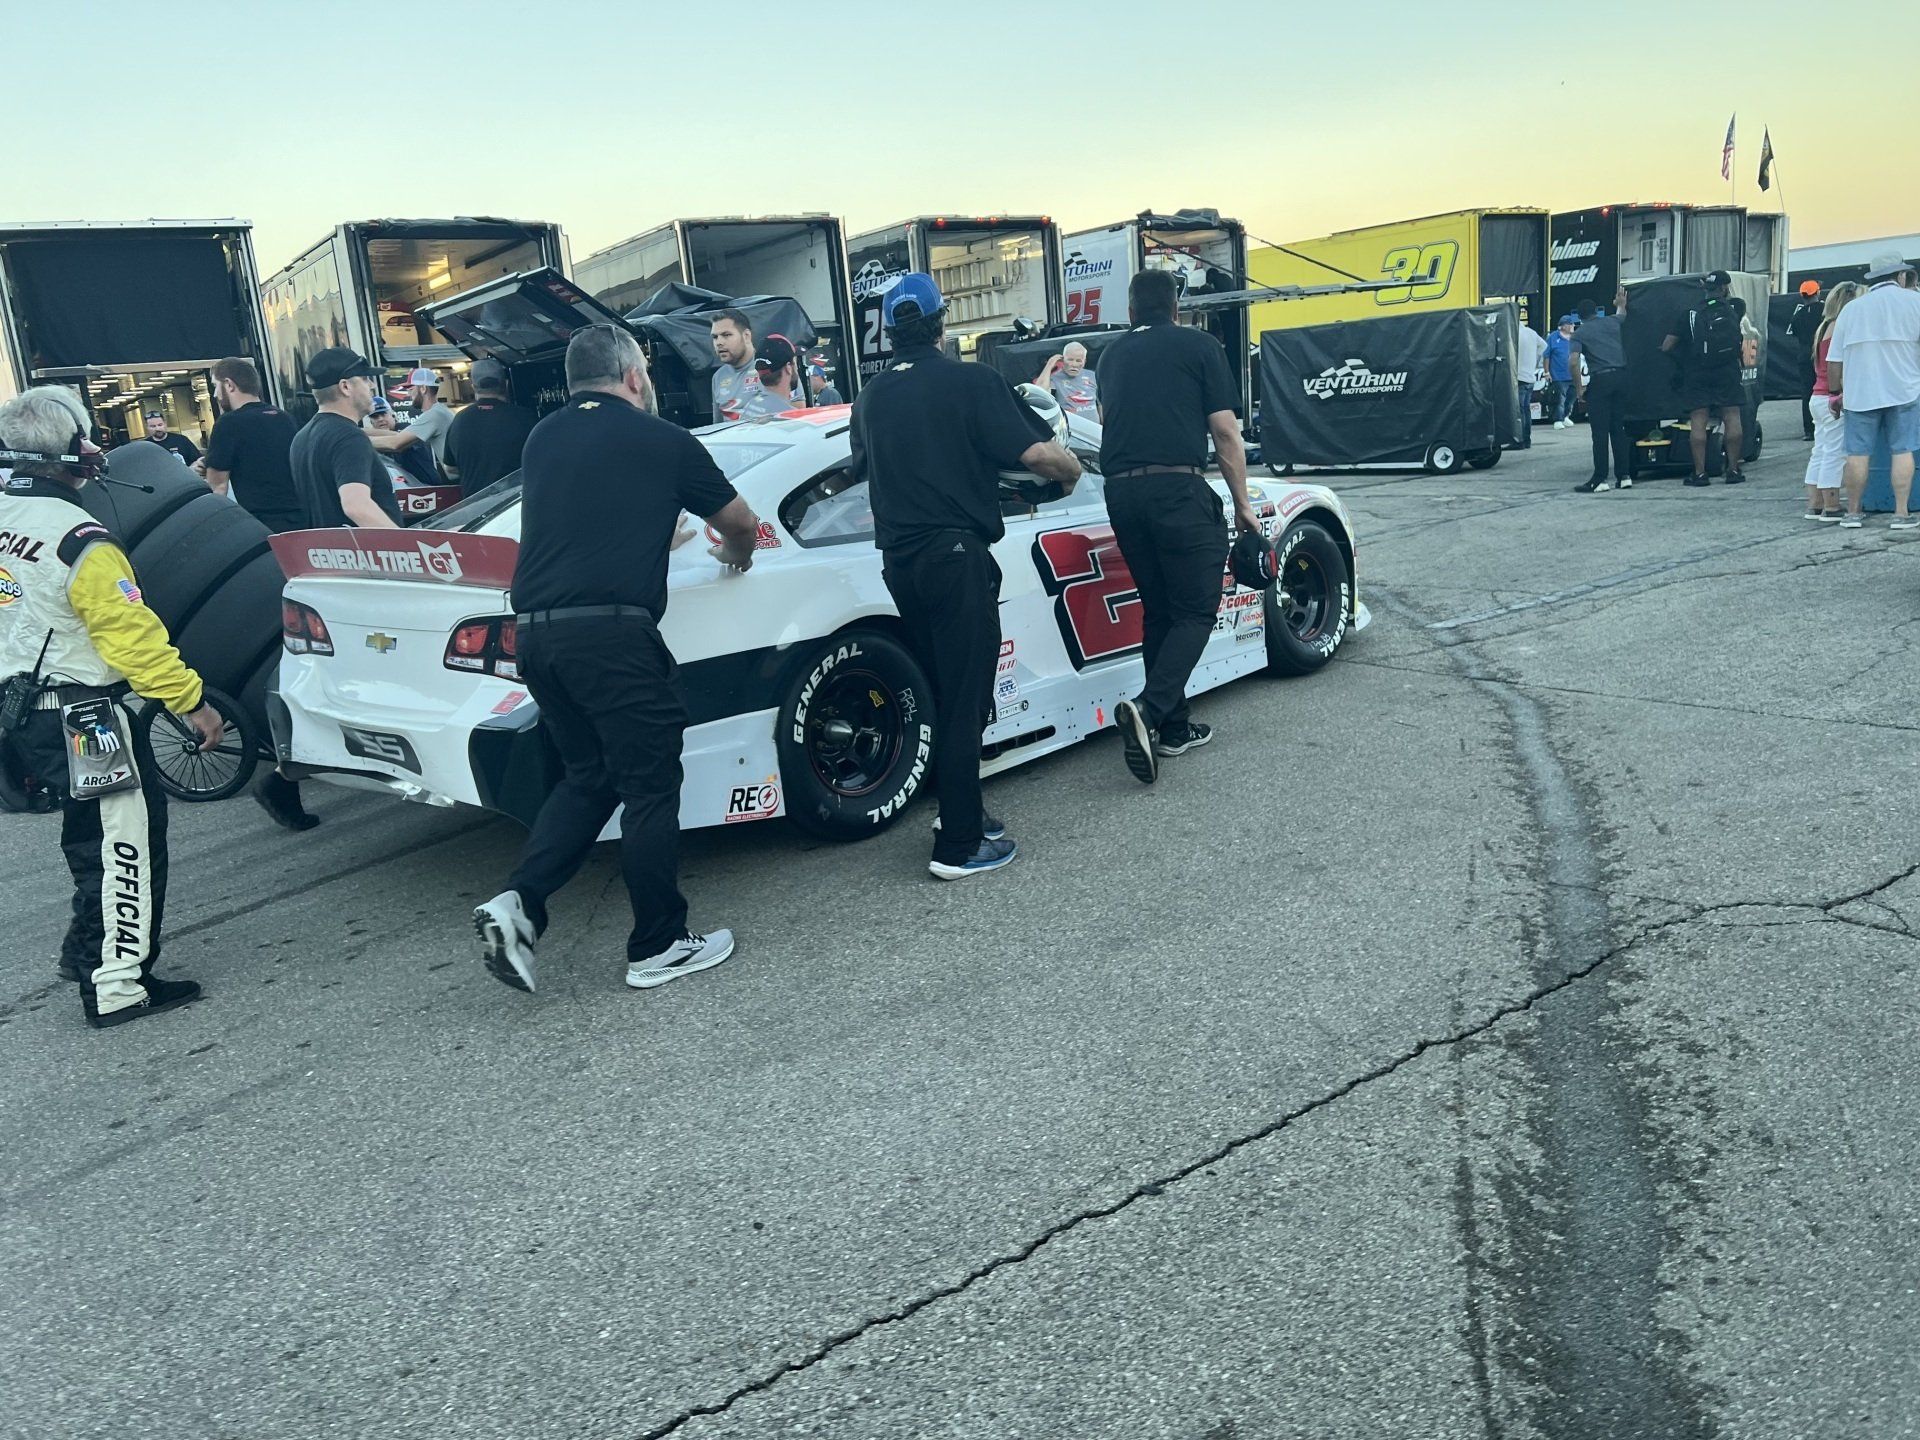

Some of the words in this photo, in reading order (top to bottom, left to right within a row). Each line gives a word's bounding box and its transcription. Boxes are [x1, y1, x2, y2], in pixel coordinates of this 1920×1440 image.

[1064, 260, 1113, 277] TURINI
[1069, 271, 1111, 282] MOTORSPORTS
[1375, 239, 1459, 306] 30
[1066, 286, 1103, 325] 25
[861, 360, 885, 374] COREY
[1303, 372, 1408, 390] VENTURINI
[1341, 385, 1404, 395] MOTORSPORTS
[308, 549, 380, 571] GENERAL
[376, 550, 424, 574] TIRE
[1320, 582, 1349, 657] GENERAL
[793, 643, 863, 744] GENERAL
[82, 774, 113, 786] ARCA
[867, 723, 932, 824] GENERAL
[114, 842, 140, 960] OFFICIAL
